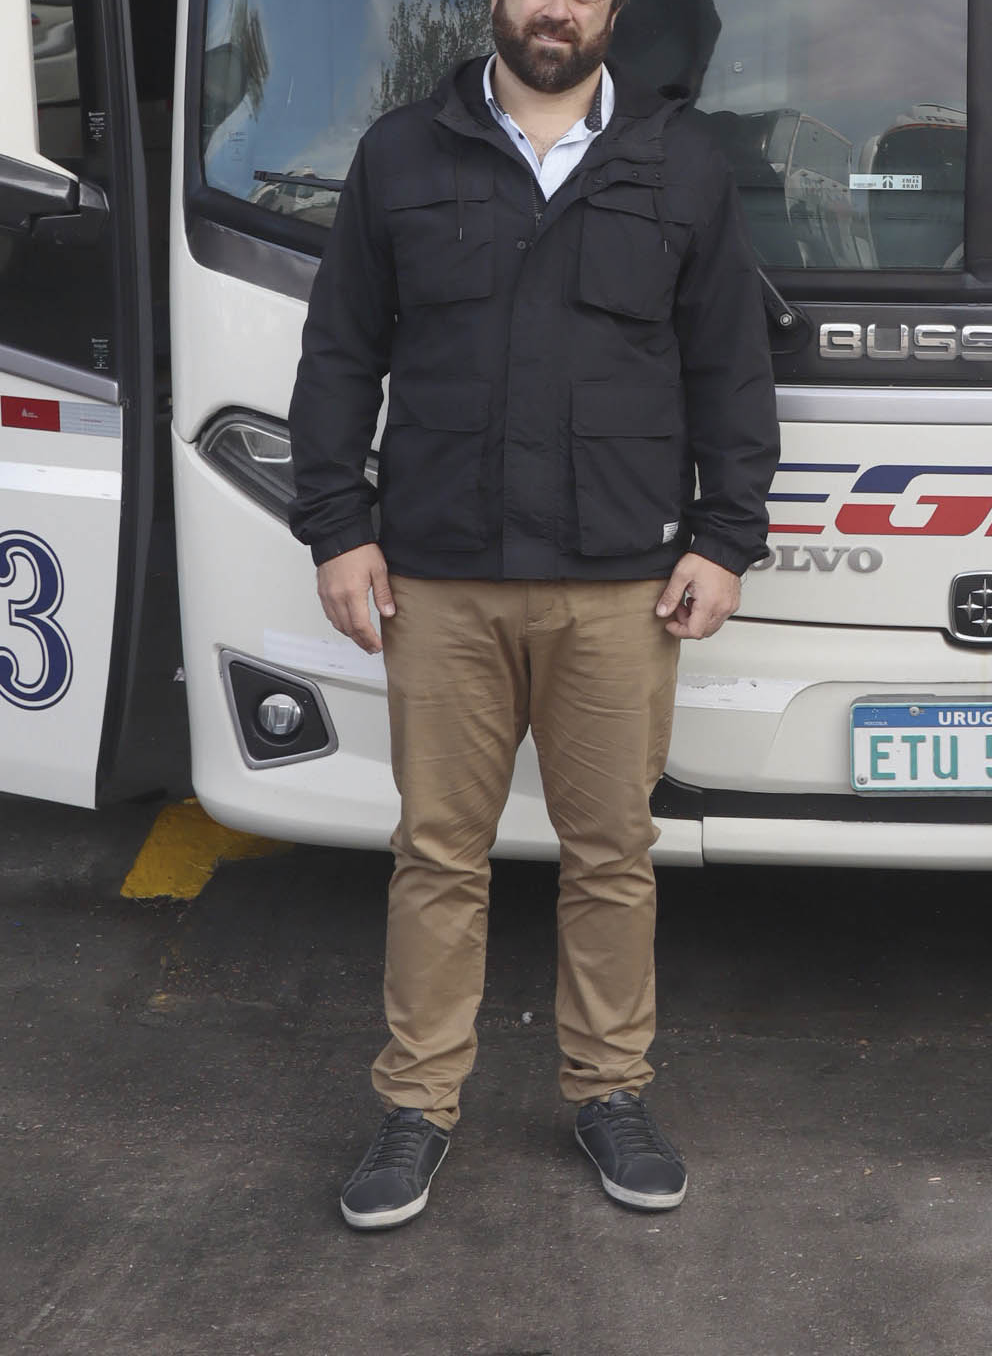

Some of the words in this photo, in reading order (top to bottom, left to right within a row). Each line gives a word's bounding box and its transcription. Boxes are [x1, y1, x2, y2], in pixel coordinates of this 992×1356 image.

[748, 544, 883, 574] OLVO
[0, 528, 74, 711] 3
[869, 734, 959, 781] ETU
